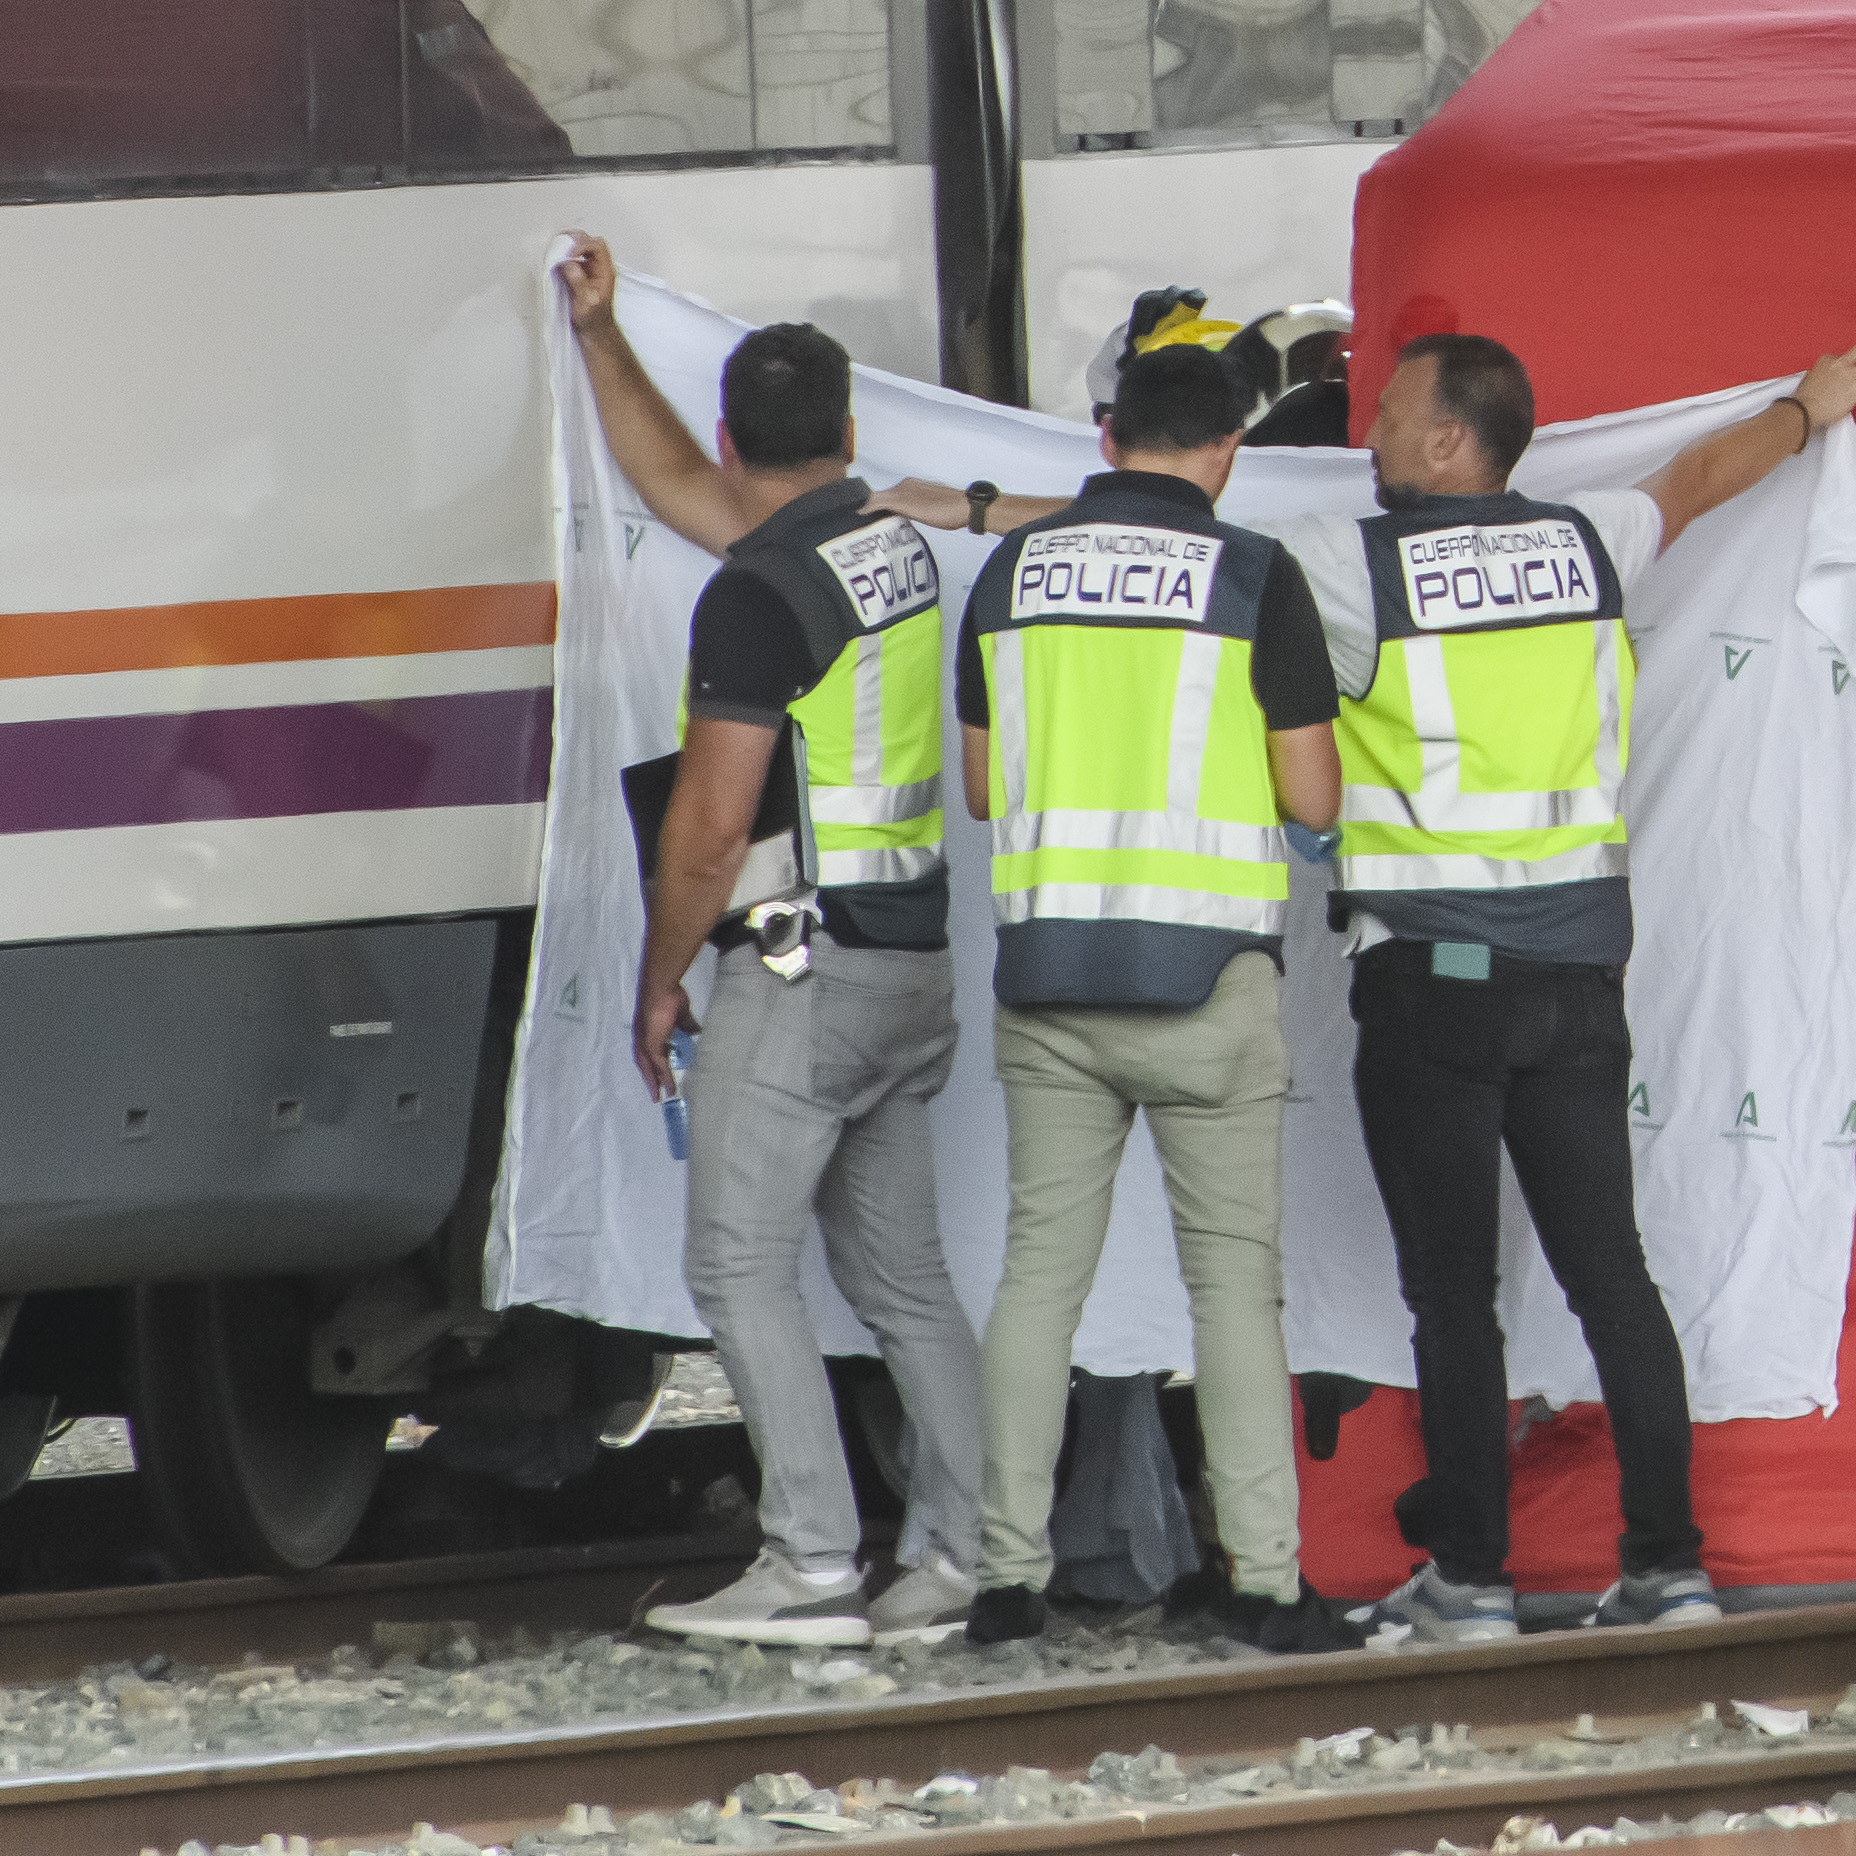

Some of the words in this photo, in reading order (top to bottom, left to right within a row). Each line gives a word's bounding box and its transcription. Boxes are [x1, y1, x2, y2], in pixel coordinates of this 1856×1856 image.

[1093, 534, 1178, 558] NACIONAL
[1182, 541, 1210, 562] DE
[1409, 534, 1481, 564] CUERPO
[1477, 528, 1558, 556] NACIONAL
[1556, 528, 1578, 548] DE
[848, 547, 936, 616] POLICI
[1018, 562, 1193, 609] POLICIA
[1414, 557, 1591, 618] POLICIA
